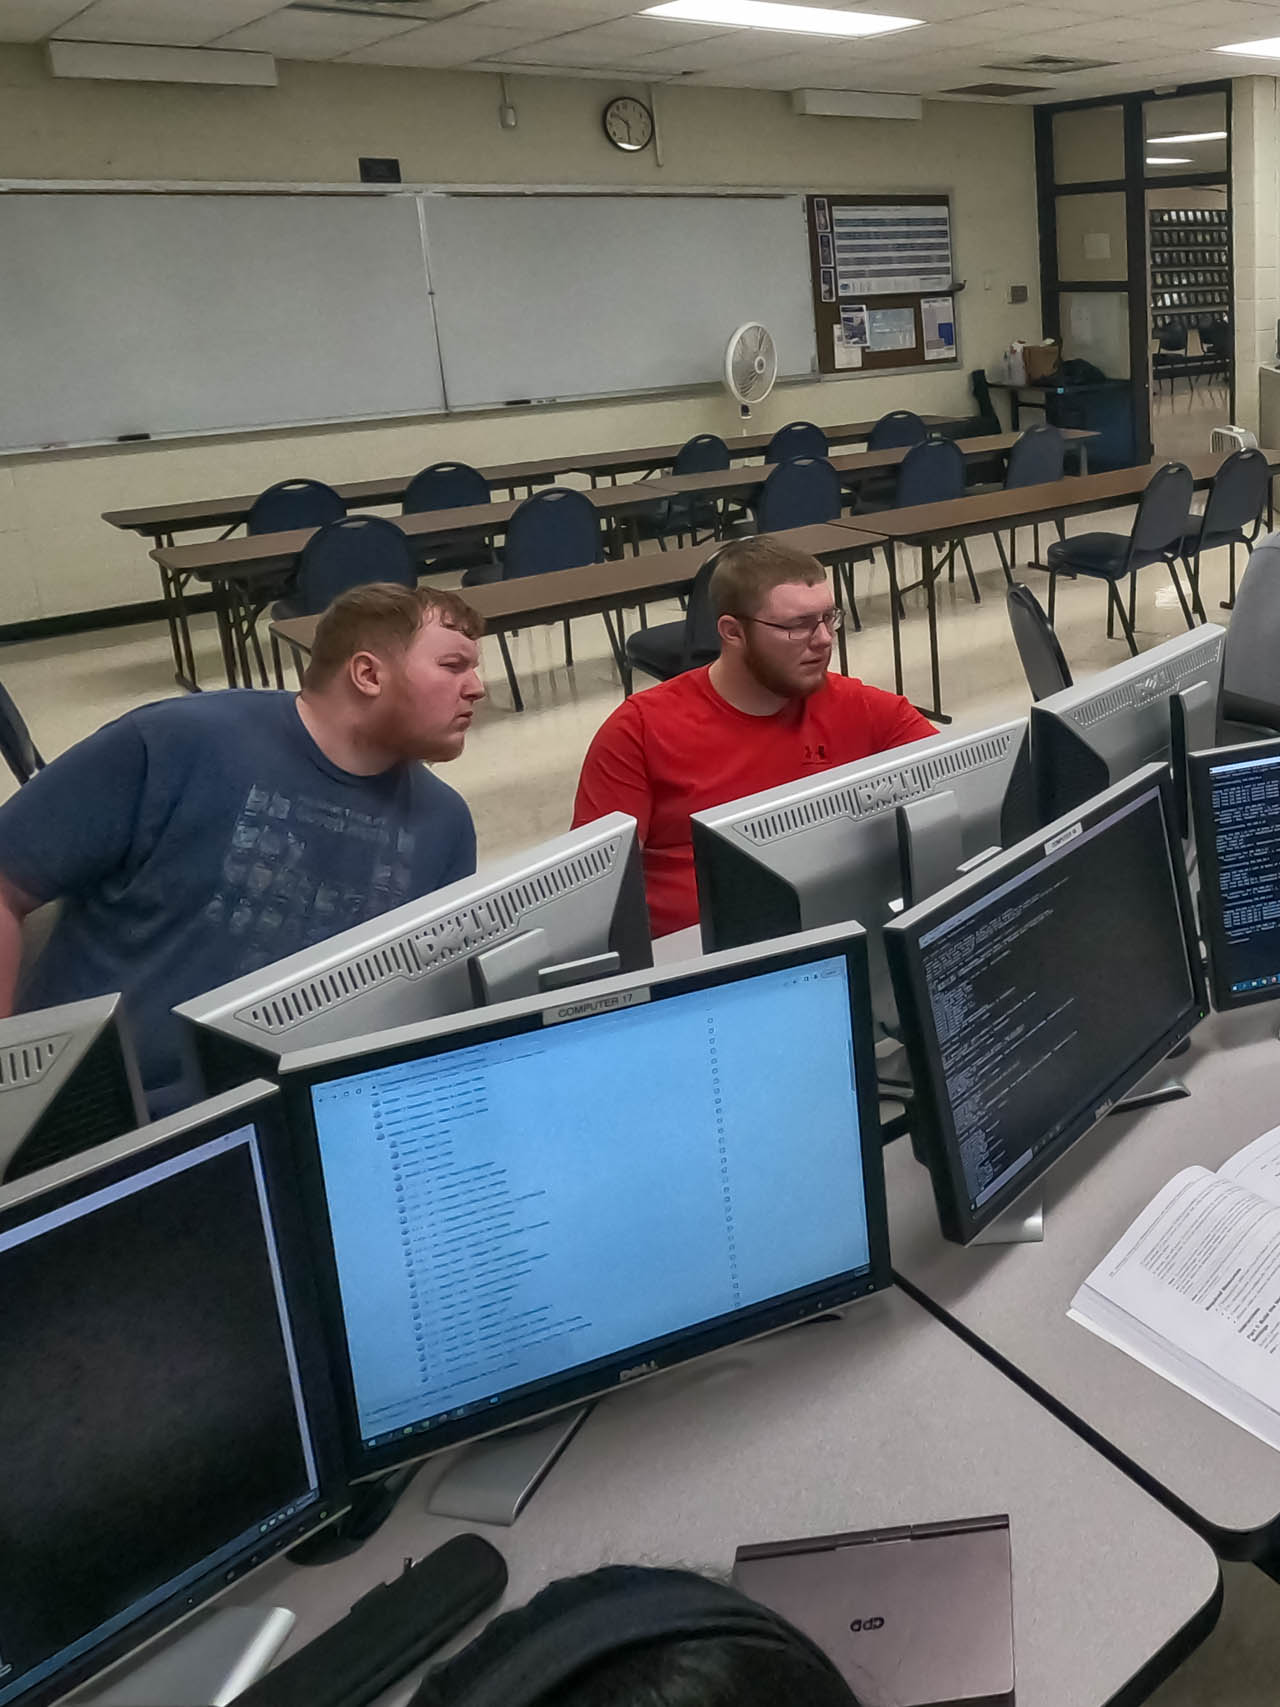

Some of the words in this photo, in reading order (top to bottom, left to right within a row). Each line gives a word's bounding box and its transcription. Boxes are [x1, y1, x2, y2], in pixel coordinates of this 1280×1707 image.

[859, 773, 920, 804] DELL
[558, 997, 619, 1017] COMPUTER
[622, 993, 633, 1003] 17
